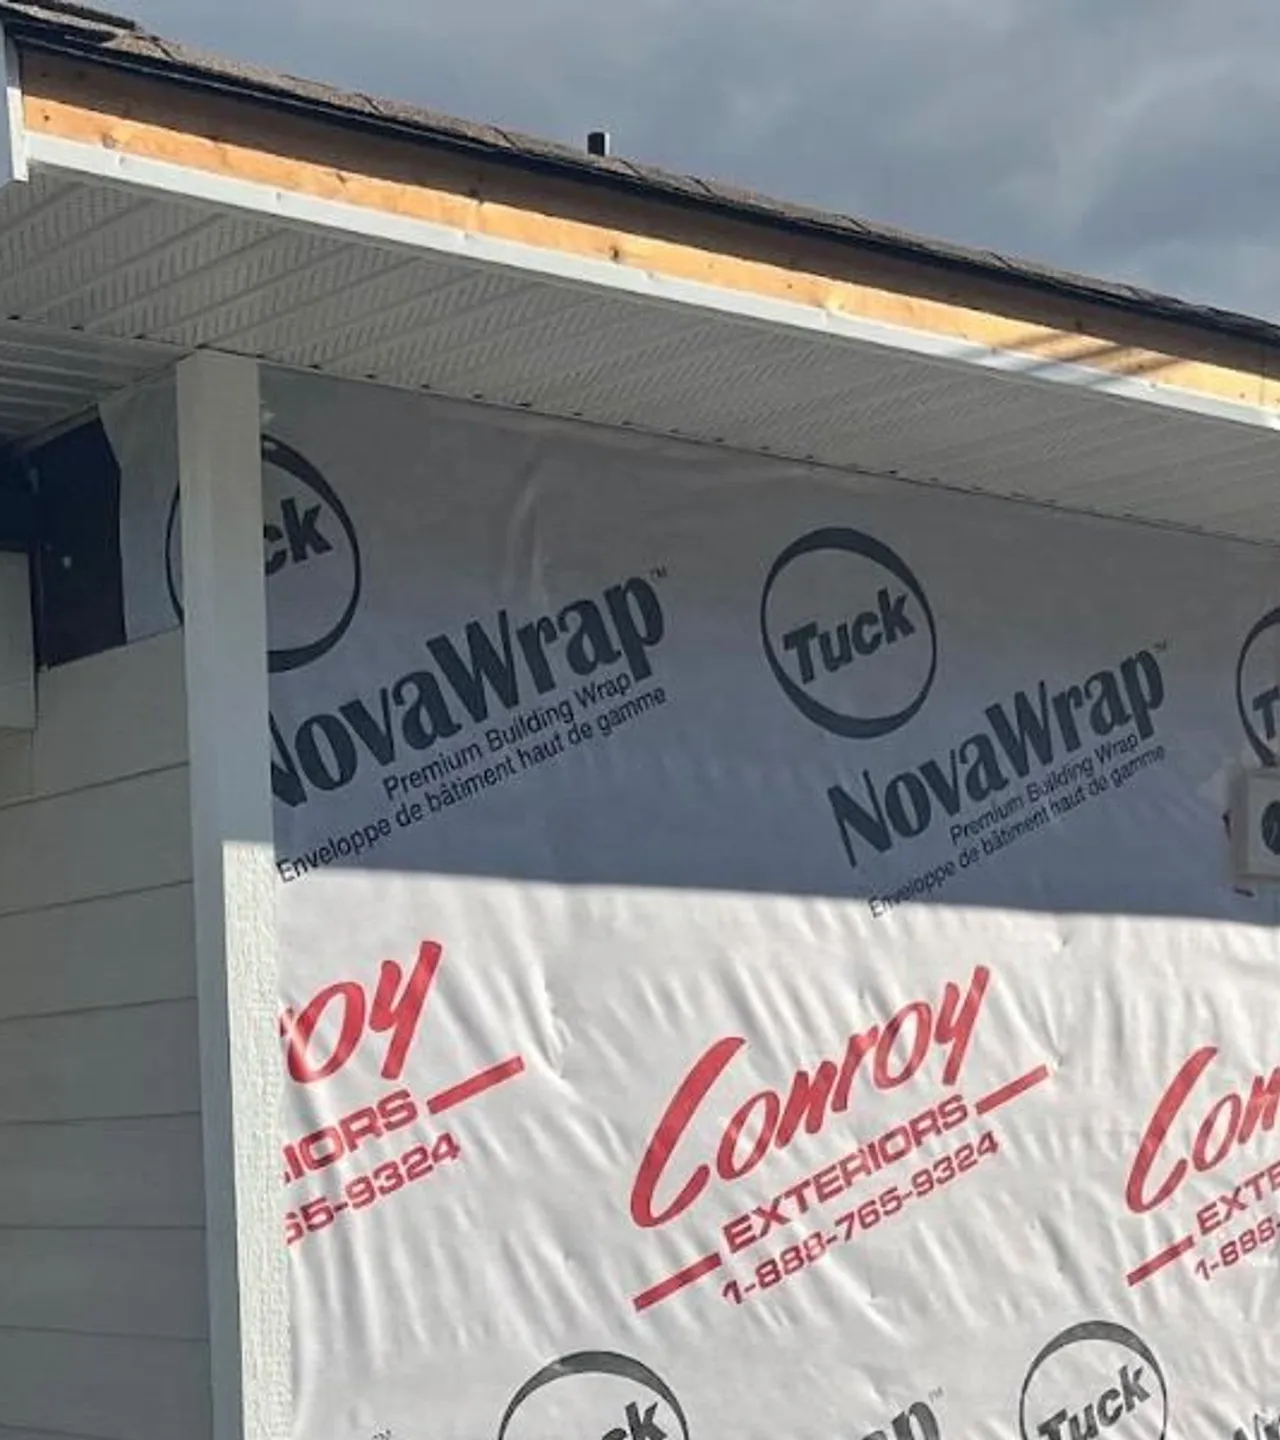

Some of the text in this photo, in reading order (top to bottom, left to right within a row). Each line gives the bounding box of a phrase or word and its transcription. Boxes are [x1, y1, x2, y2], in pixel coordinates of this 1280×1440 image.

[782, 586, 917, 685] Tuck
[276, 687, 667, 884] Enveloppe de bâtiment haut de gamme
[382, 671, 632, 800] Premium Building Wrap
[949, 732, 1139, 846] Premium Building Wrap
[868, 744, 1166, 918] Enveloppe de bâtiment haut de gamme
[629, 964, 991, 1230] Conroy
[723, 1094, 970, 1255] EXTERIORS
[720, 1130, 1001, 1306] 1-888-765-9324
